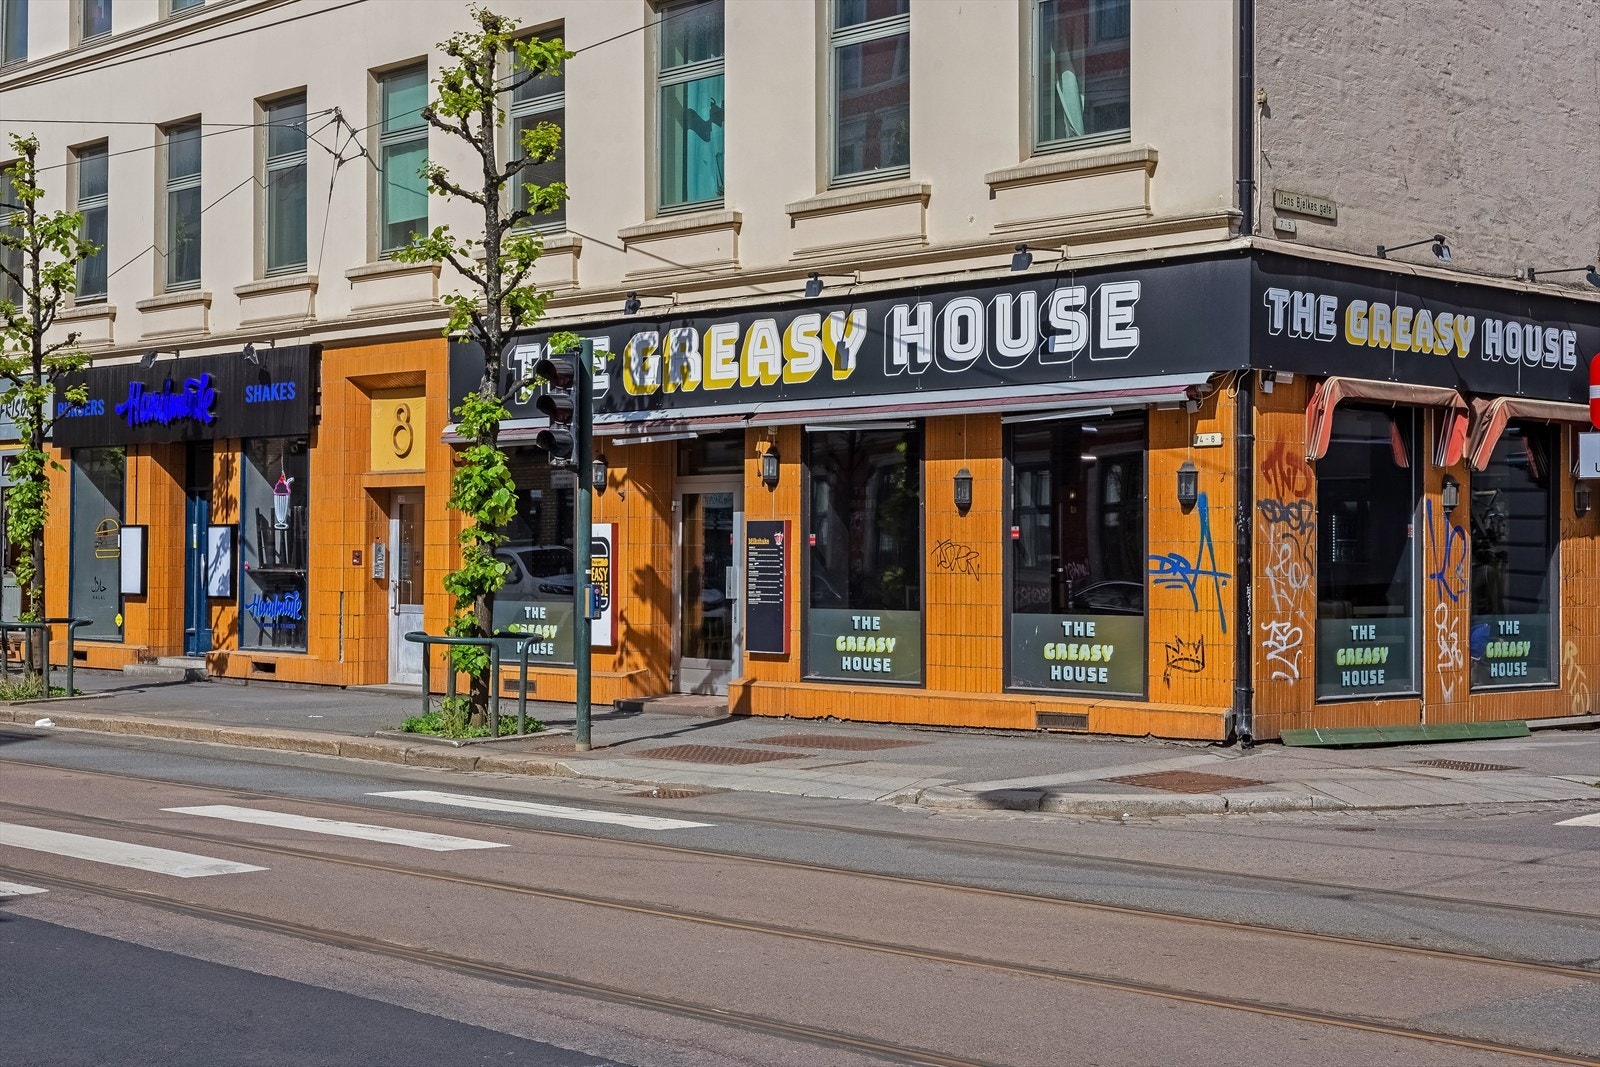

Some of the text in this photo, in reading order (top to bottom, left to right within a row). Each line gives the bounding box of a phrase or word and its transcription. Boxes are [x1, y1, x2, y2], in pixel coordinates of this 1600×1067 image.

[1280, 193, 1332, 215] Jens Bjelkes gate
[1264, 287, 1577, 371] THE GREASY HOUSE
[507, 280, 1141, 405] TE GREASY HOUSE
[115, 373, 214, 427] Handmade
[245, 381, 296, 403] SHAKES
[392, 402, 414, 459] 8
[524, 606, 546, 619] THE
[851, 615, 881, 630] THE
[1061, 621, 1096, 637] THE
[1498, 620, 1520, 636] THE
[1350, 624, 1376, 641] THE
[835, 635, 896, 654] GREASY
[1043, 642, 1114, 662] GREASY
[1486, 640, 1531, 659] GREASY
[841, 656, 891, 672] HOUSE
[1336, 646, 1389, 666] GREASY
[1050, 665, 1108, 684] HOUSE
[1341, 669, 1385, 687] HOUSE
[1490, 661, 1528, 678] HOUSE
